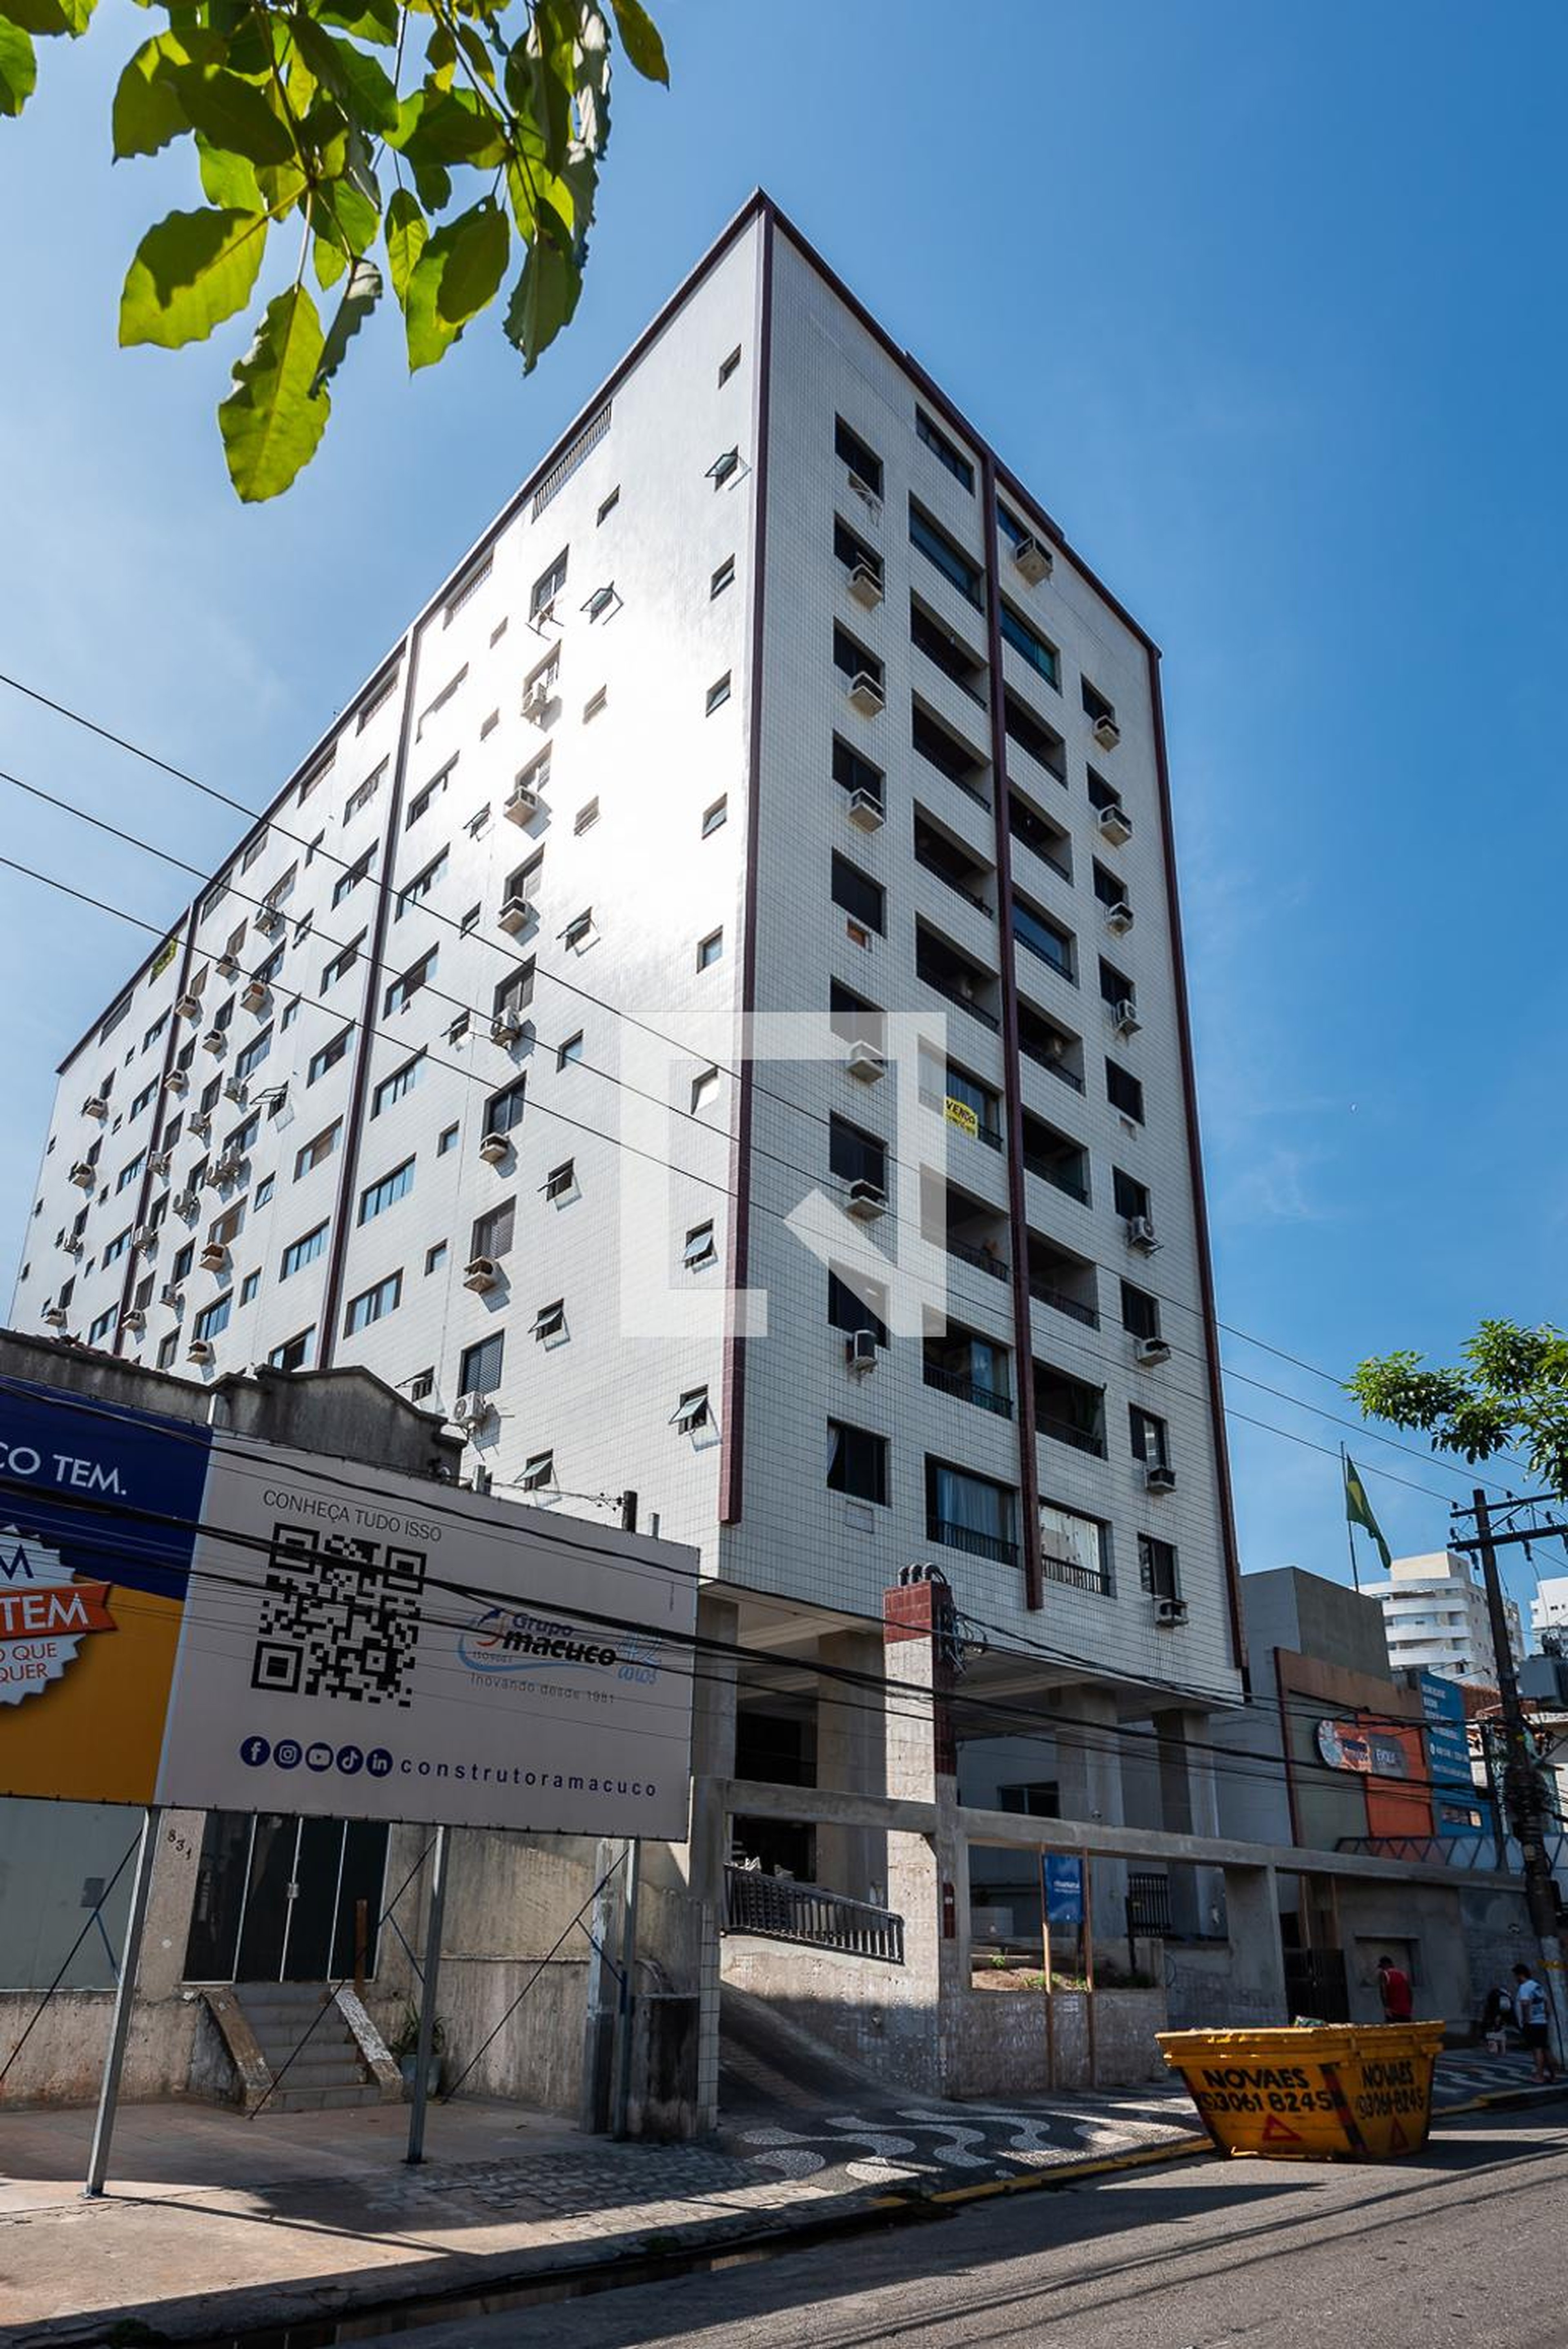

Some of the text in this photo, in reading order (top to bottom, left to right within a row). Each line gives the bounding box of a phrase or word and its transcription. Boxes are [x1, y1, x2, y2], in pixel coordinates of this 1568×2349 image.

[53, 1454, 127, 1495] TEM.
[263, 1490, 442, 1541] CONHEÇA TUDO ISSO
[0, 1593, 88, 1632] TEM
[513, 1613, 572, 1637] Grupo
[13, 1642, 57, 1661] QUE
[503, 1632, 616, 1666] macuco
[471, 1673, 535, 1692] Inovando
[401, 1759, 656, 1796] construtoramacuco
[1203, 2069, 1309, 2089] NOVAES
[1362, 2061, 1414, 2088] NOVAES
[1270, 2091, 1333, 2112] 8245
